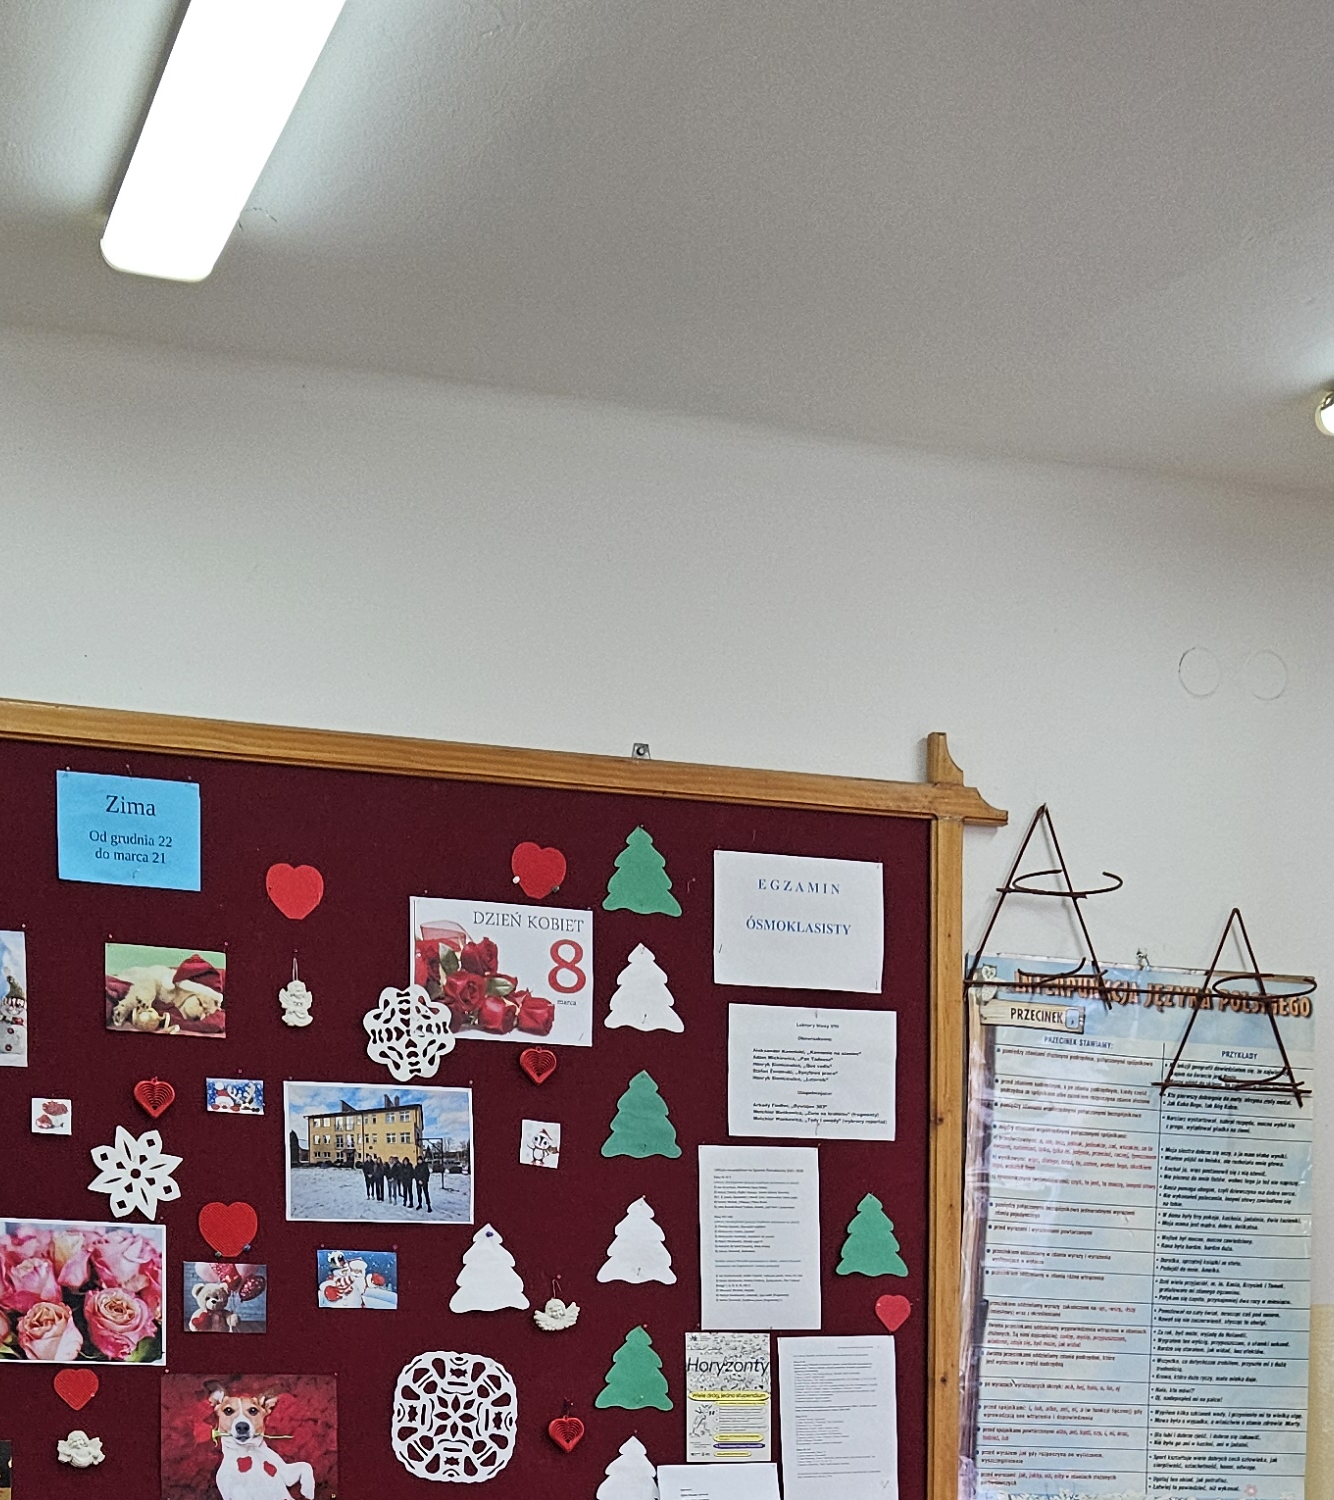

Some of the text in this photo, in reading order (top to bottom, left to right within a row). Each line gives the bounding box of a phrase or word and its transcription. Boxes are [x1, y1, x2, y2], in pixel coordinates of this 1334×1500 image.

[106, 794, 156, 816] Zima
[89, 830, 173, 848] Od grudnia 22
[95, 847, 166, 864] do marca 21
[473, 910, 584, 933] DZIEŃ KOBIET
[745, 916, 852, 936] ÓSMOKLASISTY
[547, 939, 586, 994] 8
[1011, 1007, 1064, 1025] PRZECINEK
[687, 1356, 770, 1377] Horyzonty
